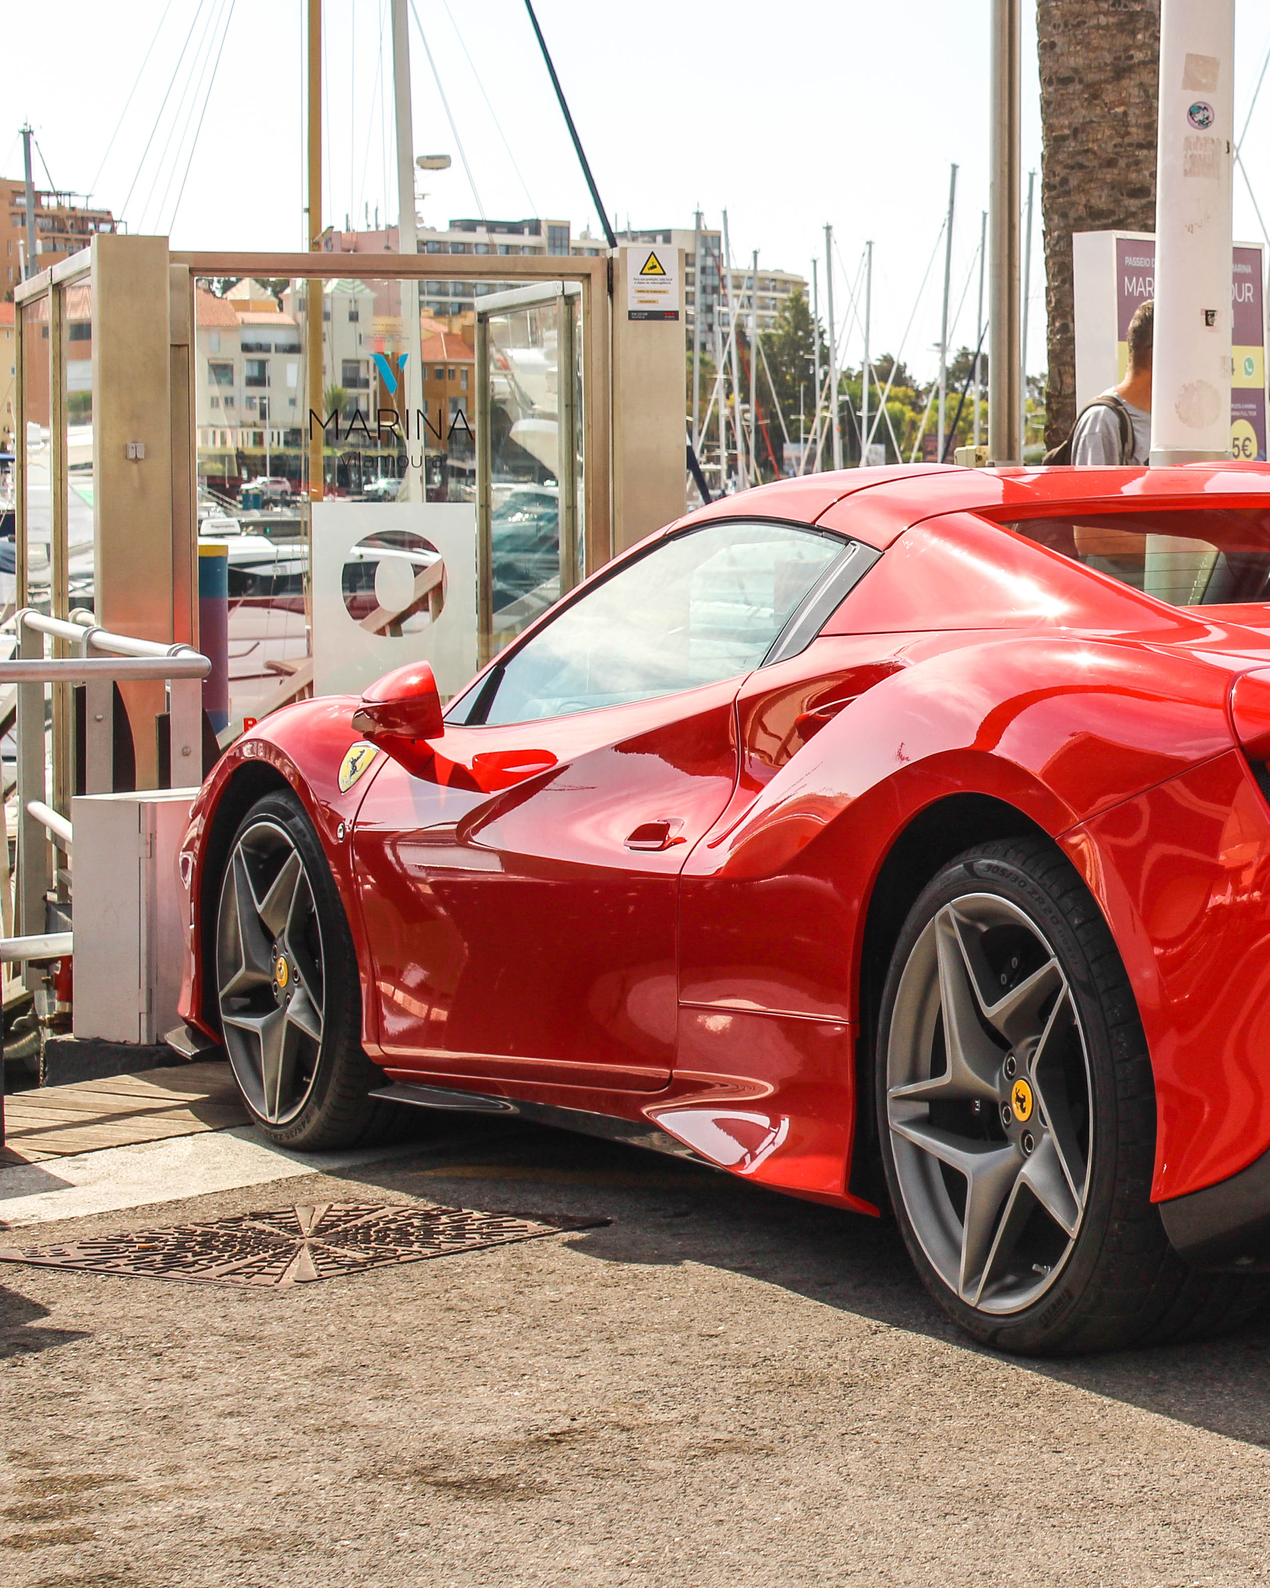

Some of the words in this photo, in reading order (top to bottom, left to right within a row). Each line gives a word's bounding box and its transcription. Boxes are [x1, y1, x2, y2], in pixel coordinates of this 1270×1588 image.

[1124, 256, 1151, 267] PASSEIO
[1124, 276, 1154, 297] MAR
[309, 408, 474, 441] MARINA
[340, 451, 443, 469] vilamoura
[983, 863, 1027, 888] 305/30
